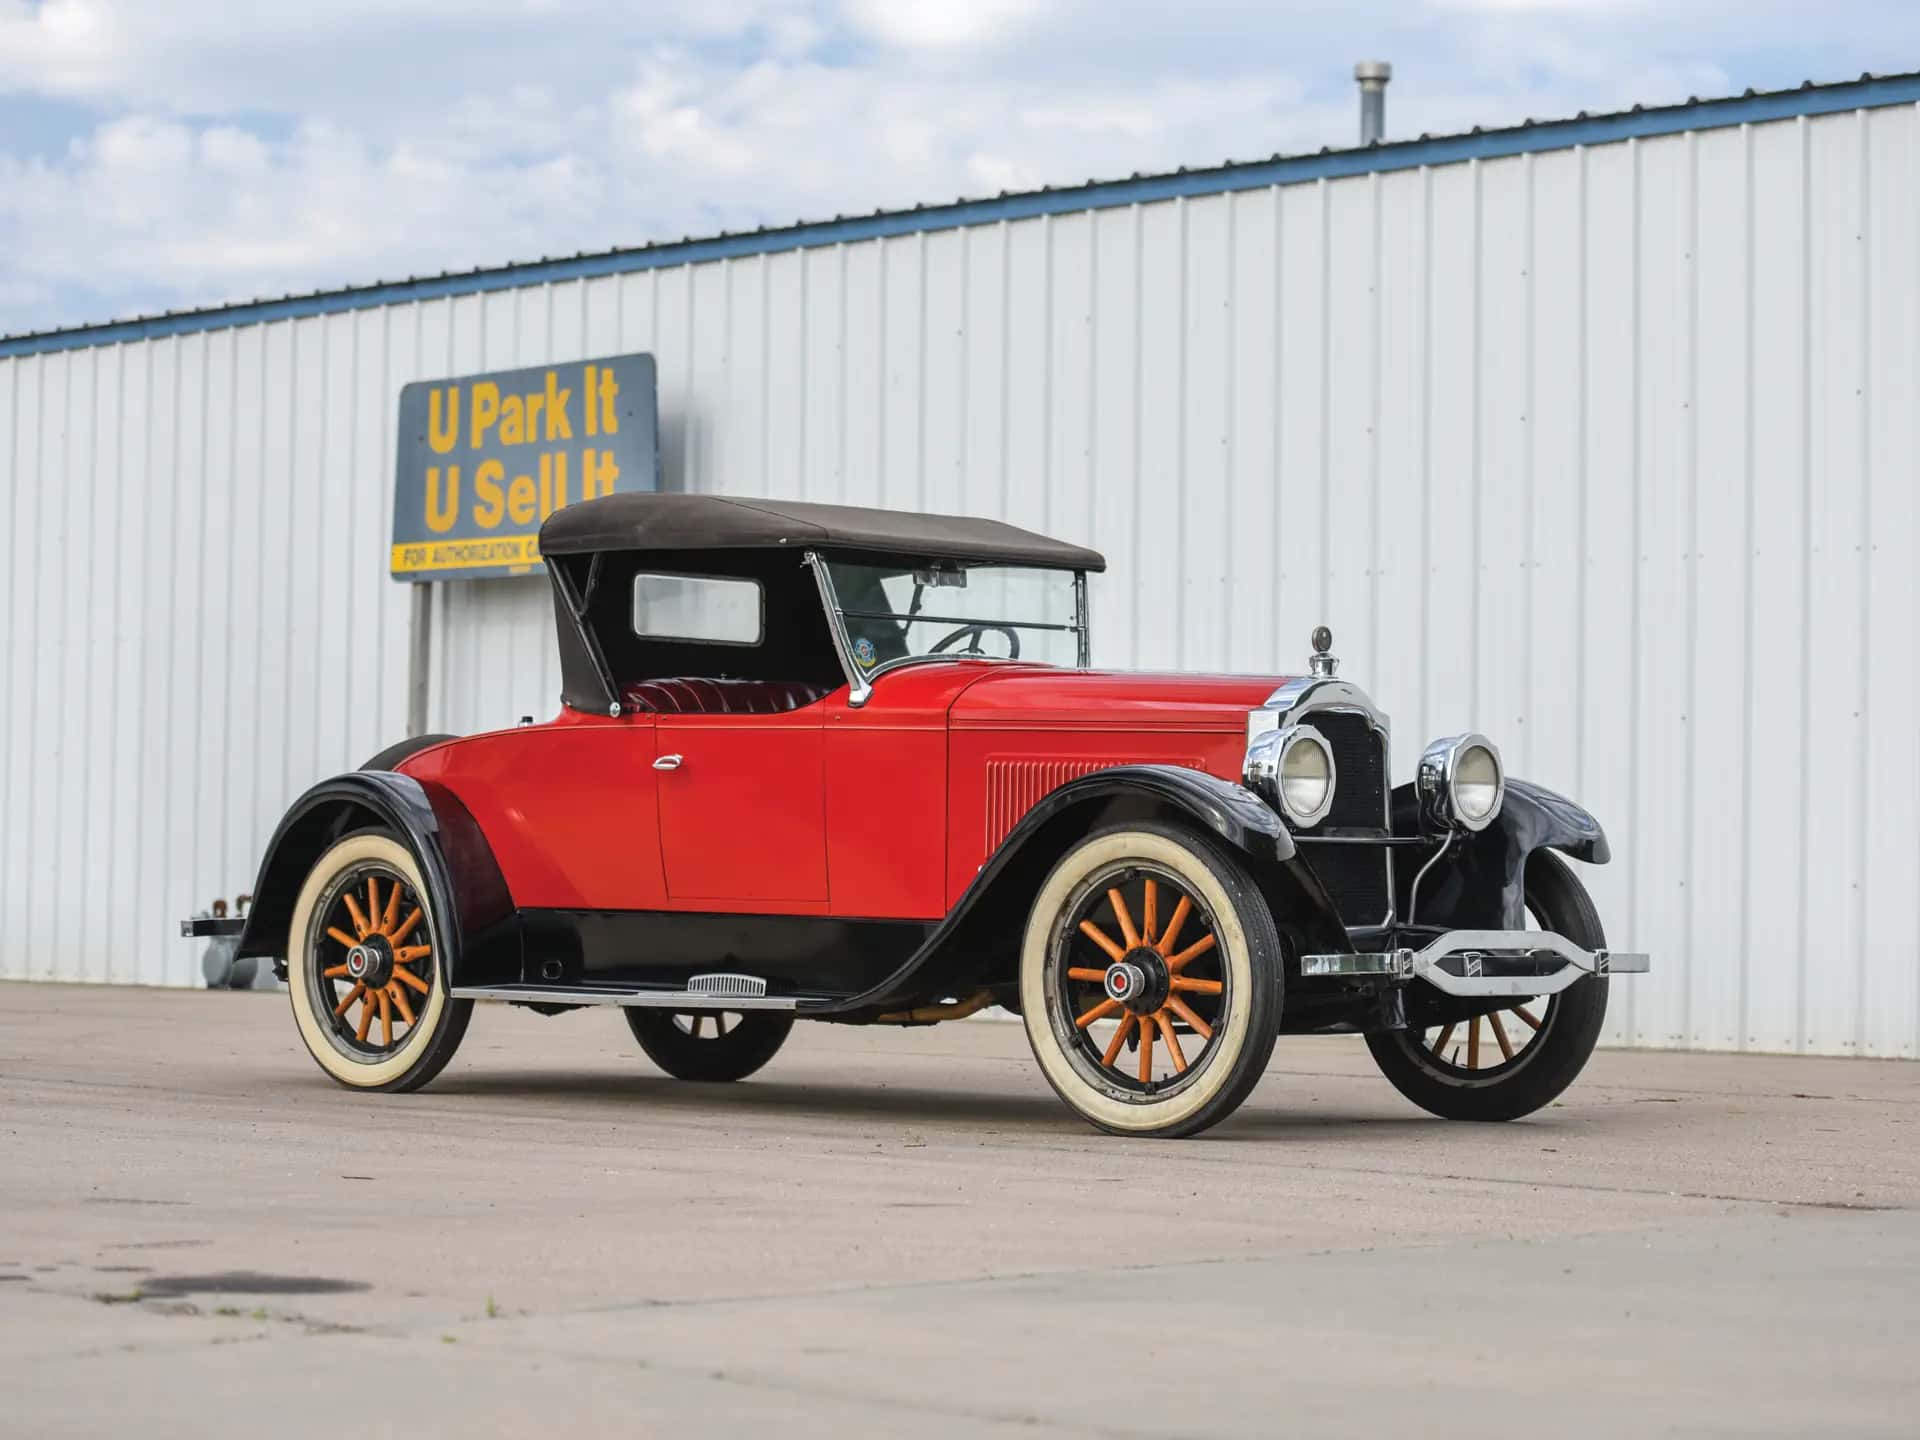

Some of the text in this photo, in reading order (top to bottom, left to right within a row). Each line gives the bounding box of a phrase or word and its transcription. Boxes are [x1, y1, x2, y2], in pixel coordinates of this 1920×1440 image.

[428, 365, 619, 454] U Park It
[425, 448, 619, 532] U Sell It
[404, 547, 426, 566] FOR
[432, 543, 520, 563] AUTHORIZATION
